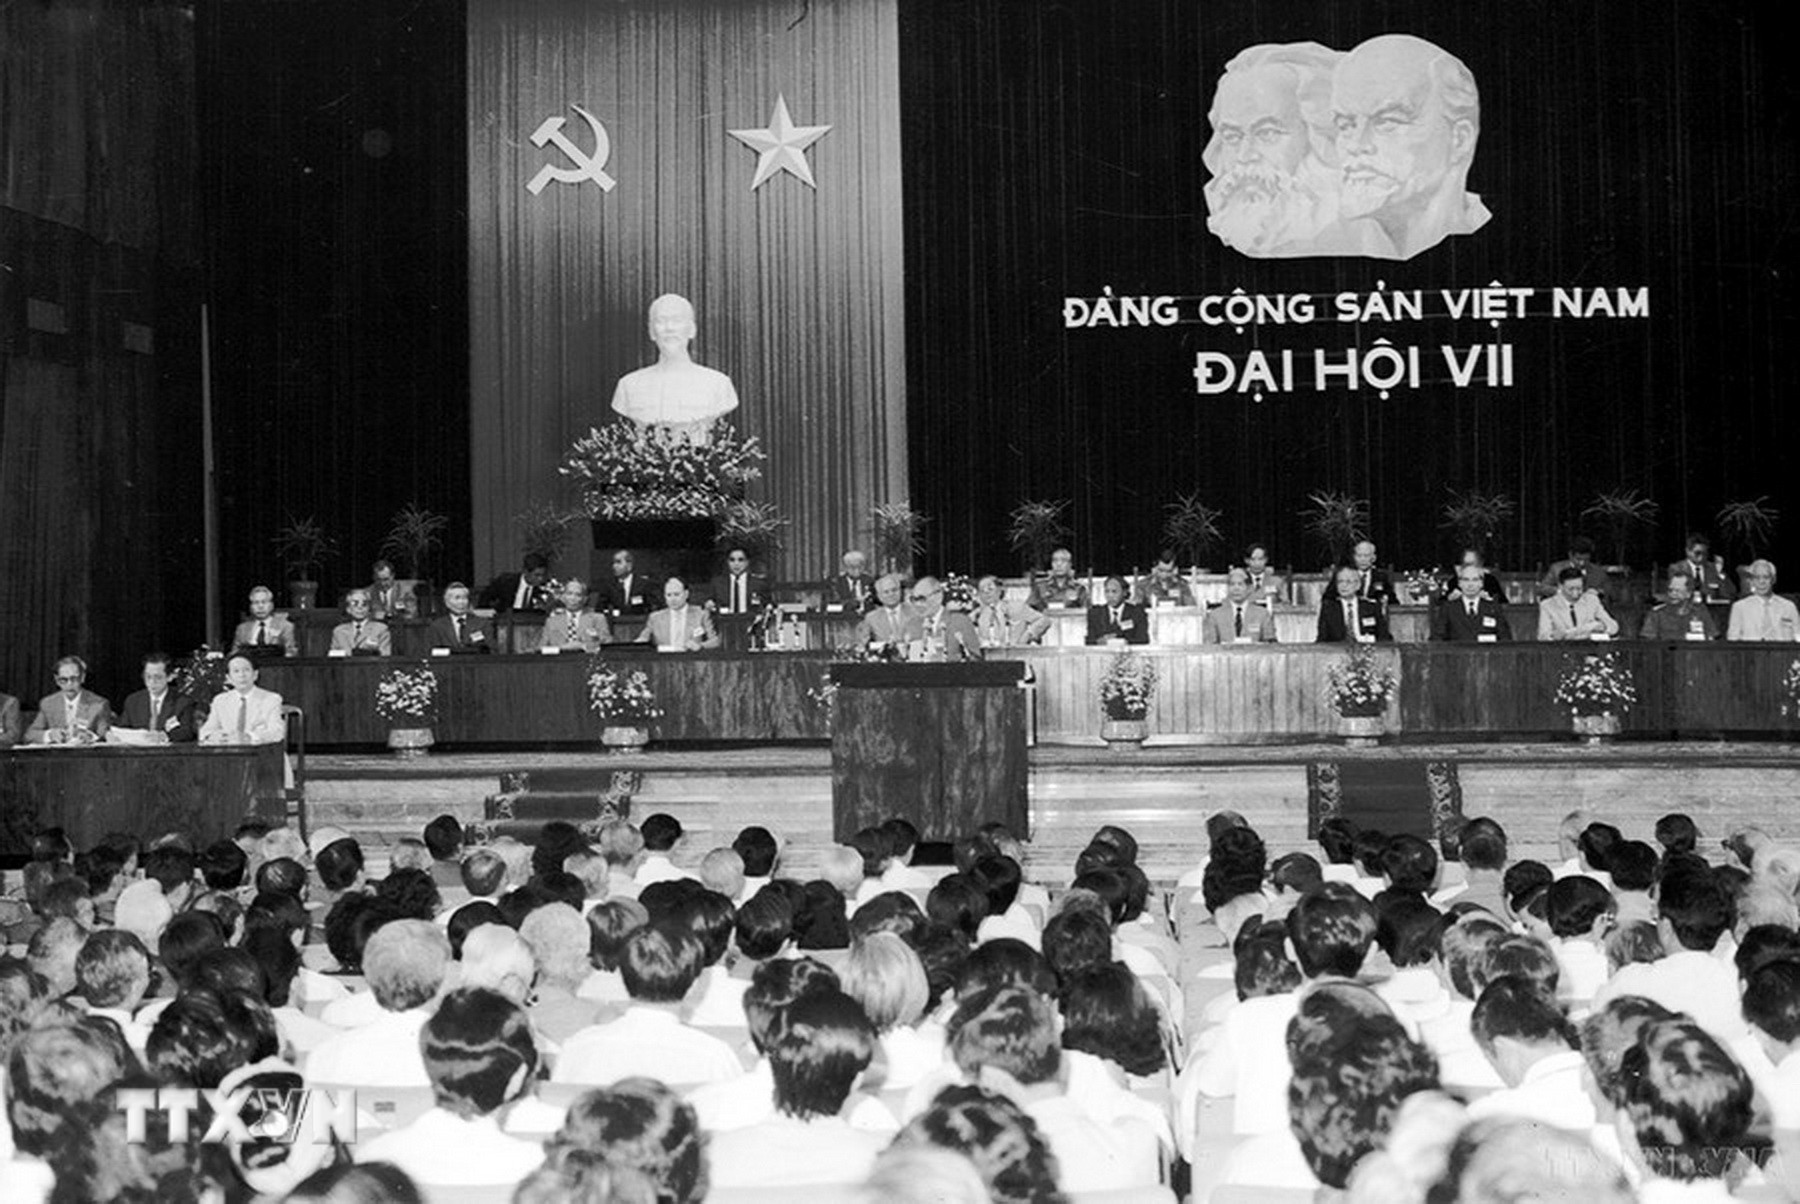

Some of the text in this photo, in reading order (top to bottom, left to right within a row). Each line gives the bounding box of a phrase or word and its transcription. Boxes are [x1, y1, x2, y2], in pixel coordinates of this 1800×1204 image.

[1063, 280, 1650, 334] ĐẢNG CỘNG SẢN VIỆT NAM
[1193, 338, 1513, 402] ĐẠI HỘI VII
